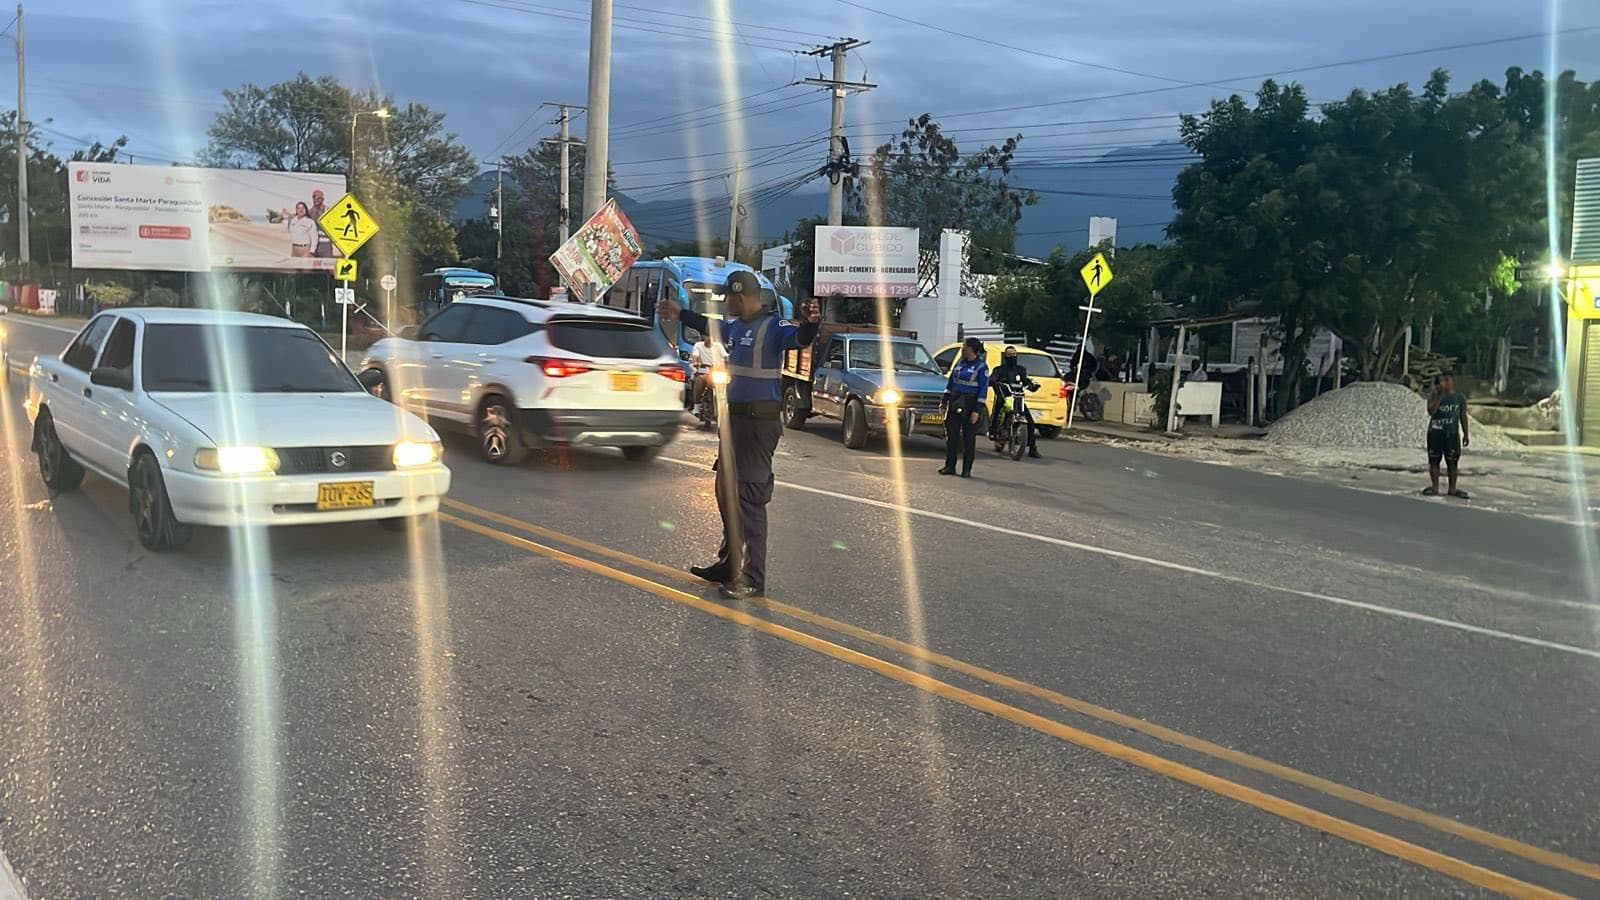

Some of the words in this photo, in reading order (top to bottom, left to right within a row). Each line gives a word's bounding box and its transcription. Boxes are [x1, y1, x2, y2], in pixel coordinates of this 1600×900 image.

[114, 195, 134, 203] Santa
[136, 196, 156, 204] Marta
[817, 265, 845, 273] BLOQUES
[881, 266, 916, 274] AGREGADOS
[843, 284, 862, 295] 301
[890, 285, 916, 295] 1296
